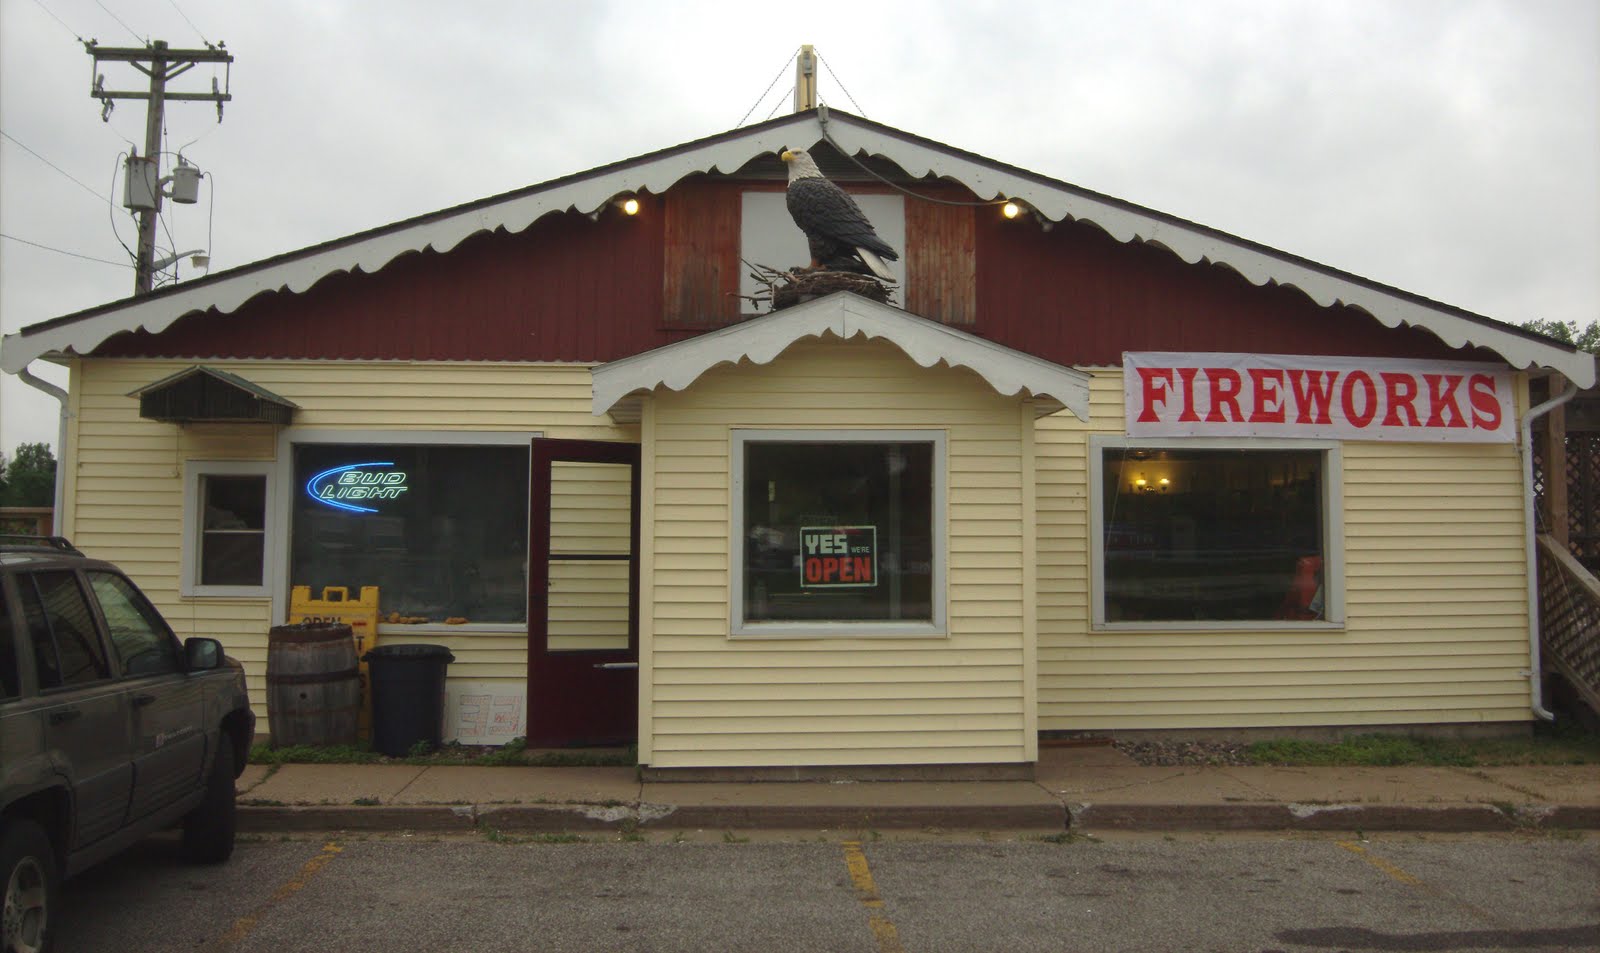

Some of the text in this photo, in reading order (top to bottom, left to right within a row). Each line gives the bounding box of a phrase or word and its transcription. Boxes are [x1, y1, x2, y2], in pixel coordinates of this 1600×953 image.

[1136, 367, 1502, 431] FIREWORKS
[338, 471, 407, 485] BUD
[320, 485, 408, 499] LIGHT
[805, 534, 848, 555] YES
[806, 556, 871, 582] OPEN
